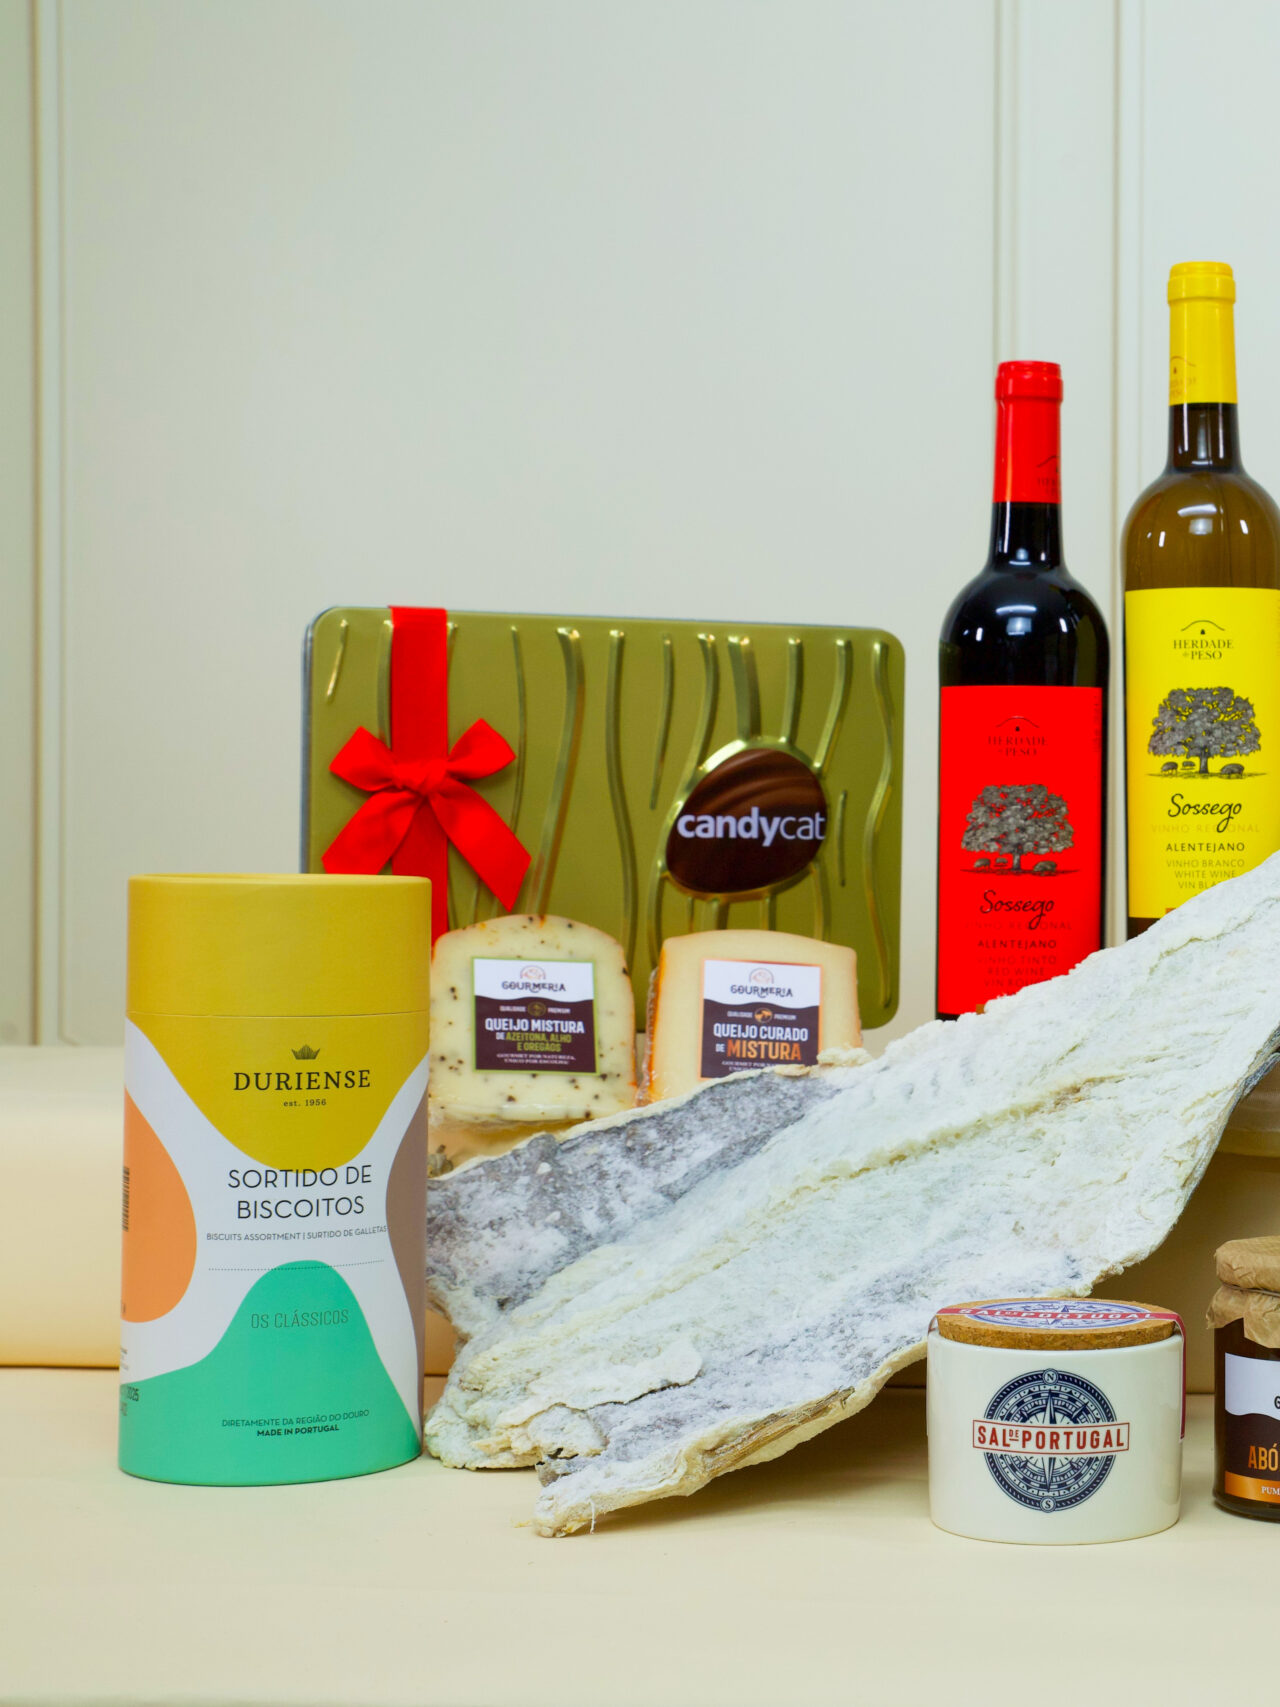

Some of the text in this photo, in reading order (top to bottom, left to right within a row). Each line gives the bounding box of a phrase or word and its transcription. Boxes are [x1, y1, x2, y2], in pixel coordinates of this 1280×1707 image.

[1173, 639, 1234, 649] HERDADE
[1191, 651, 1222, 660] PESO
[1168, 793, 1242, 833] Sossego
[677, 806, 826, 847] candycat
[1196, 823, 1260, 833] REGONAL
[1166, 842, 1245, 853] ALENTEJANO
[1166, 859, 1245, 868] VINHO BRANCO
[1175, 870, 1237, 878] WHITE WINE
[1178, 881, 1218, 889] VIN BLA
[980, 890, 1055, 930] Sossego
[1009, 921, 1073, 930] REGONAL
[977, 939, 1057, 950] ALENTEJANO
[1021, 955, 1057, 965] TINTO
[1015, 967, 1044, 976] WINE
[485, 1018, 585, 1034] QUEIJO MISTURA
[496, 1032, 505, 1040] DE
[550, 1033, 572, 1043] ALHO
[713, 1023, 808, 1041] QUEIJO CURADO
[517, 1042, 522, 1051] E
[715, 1039, 802, 1060] DE MISTURA
[233, 1069, 371, 1091] DURIENSE
[283, 1098, 327, 1107] est. 1956
[228, 1164, 372, 1189] SORTIDO DE
[237, 1195, 364, 1219] BISCOITOS
[206, 1225, 387, 1241] BISCUITS ASSORTMENT SURTIDO DE GALLETAS
[251, 1309, 350, 1329] OS CLÁSSICOS
[959, 1308, 1003, 1316] SAL
[1020, 1311, 1153, 1319] PORTUGAL
[222, 1409, 370, 1427] DIRETAMENTE DA REGIÃO DO DOURO
[257, 1424, 340, 1437] MADE IN PORTUGAL
[977, 1425, 1125, 1450] SAL DE PORTUGAL
